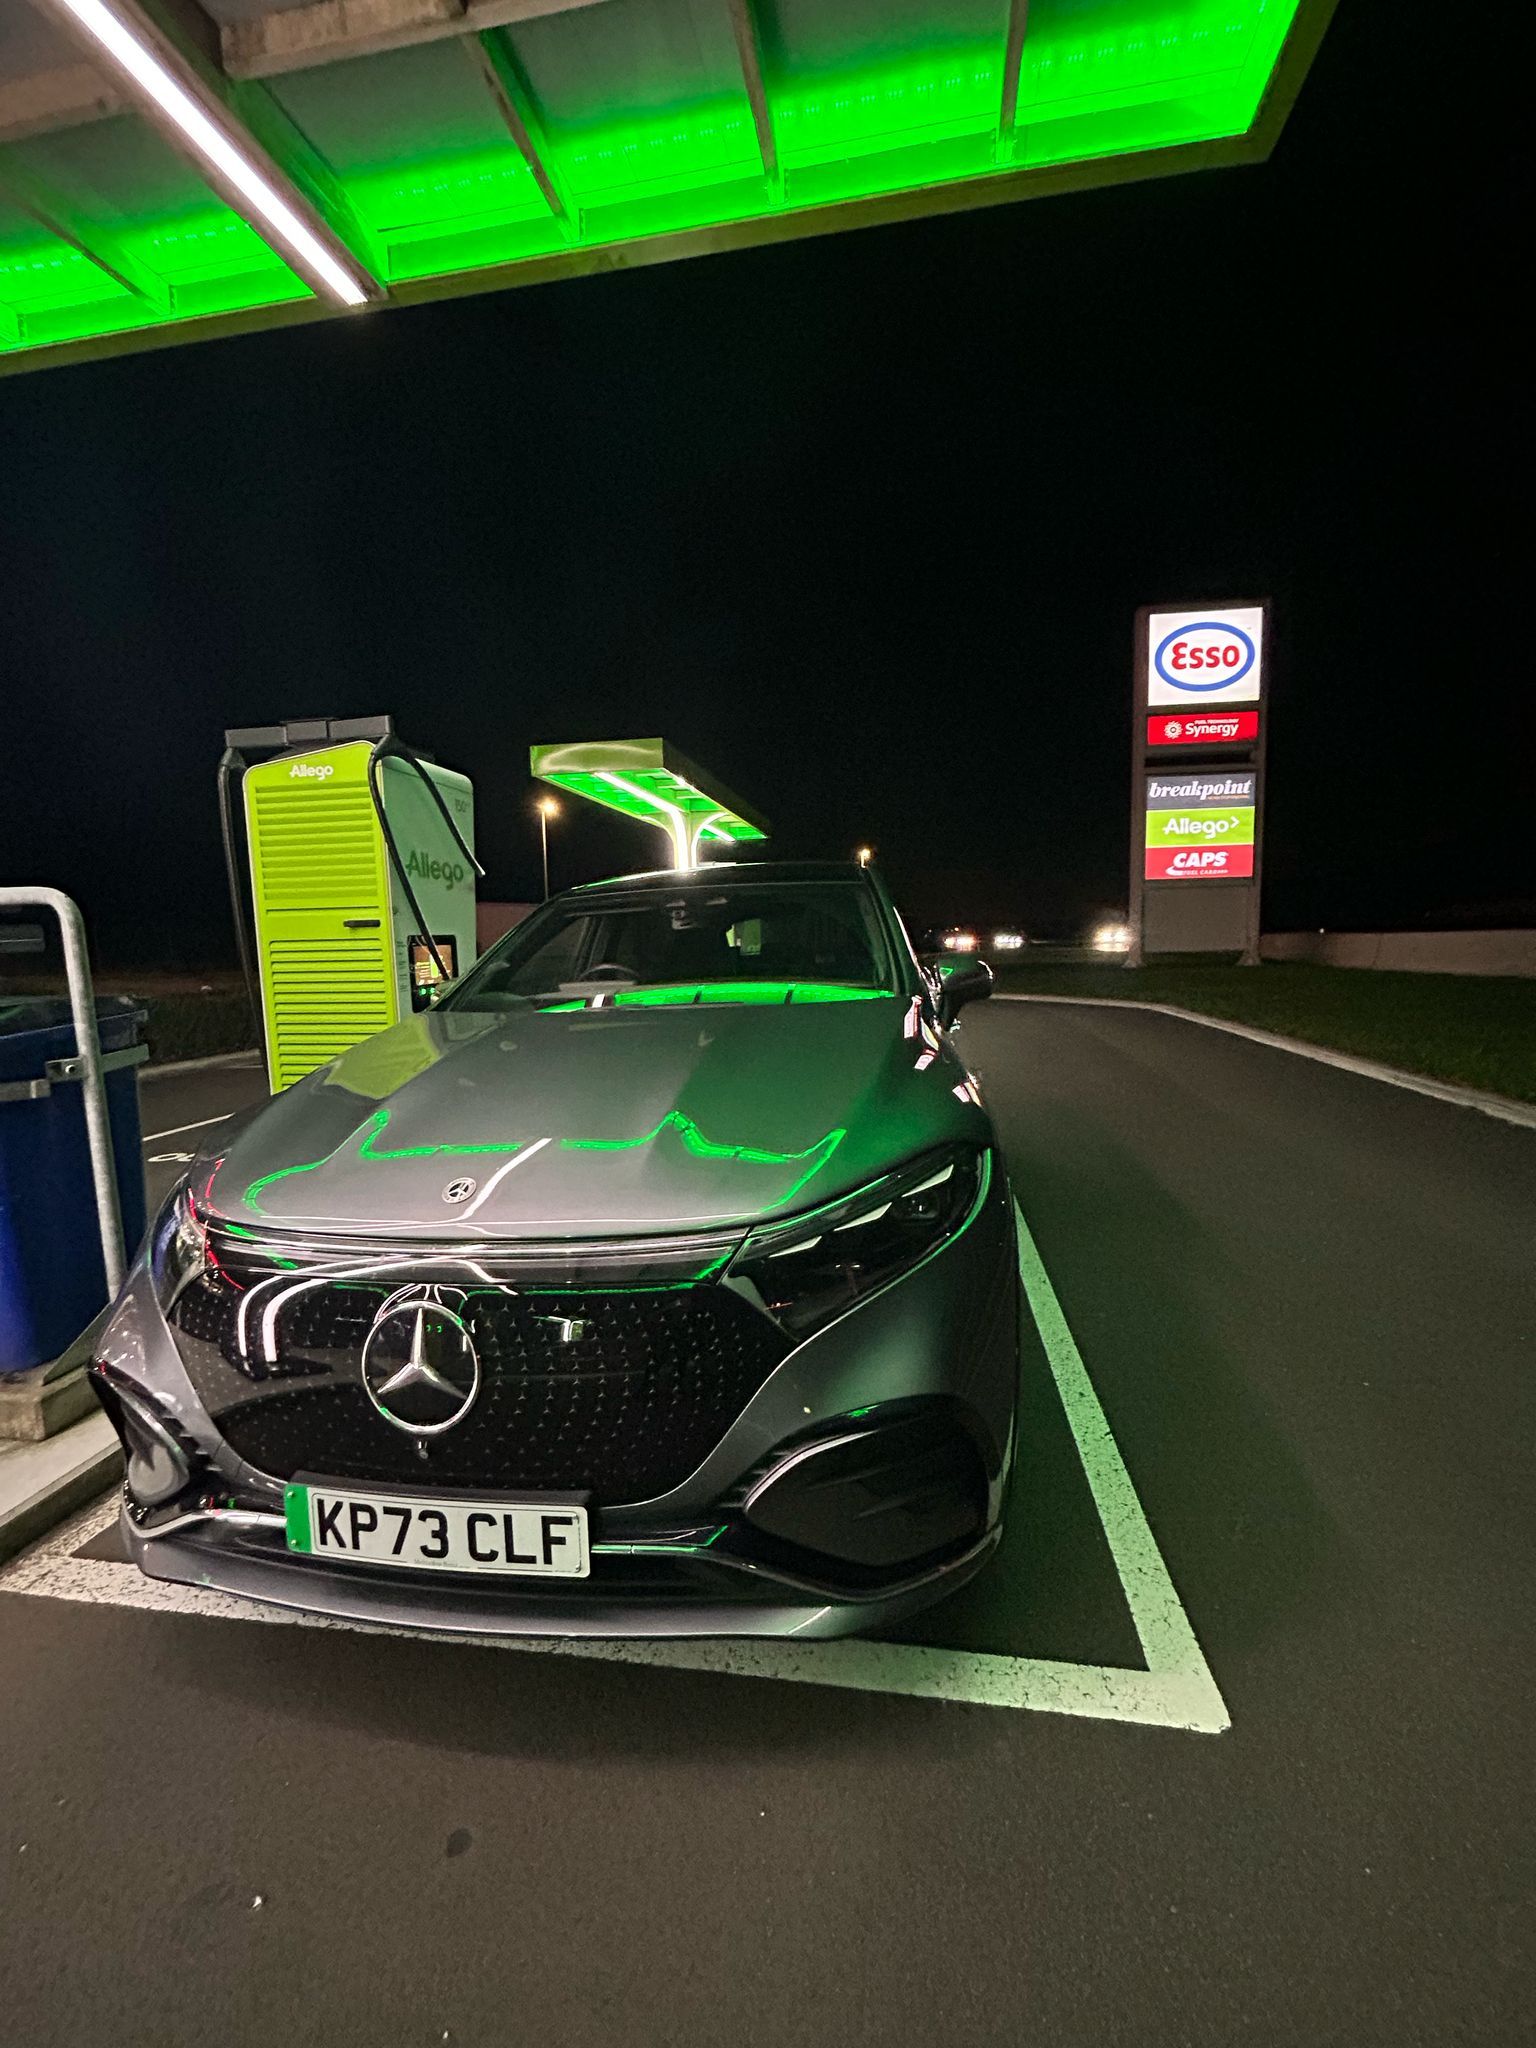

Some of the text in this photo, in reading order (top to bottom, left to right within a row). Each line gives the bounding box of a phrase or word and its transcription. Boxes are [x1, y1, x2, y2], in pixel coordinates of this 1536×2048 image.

[1171, 642, 1240, 670] Esso
[1185, 723, 1239, 737] Synergy
[289, 764, 334, 780] Allego
[1149, 780, 1252, 800] breakpoint
[1162, 817, 1229, 839] Allego
[406, 850, 464, 890] Allego
[1173, 852, 1229, 868] CAPS
[317, 1499, 573, 1565] KP73 CLF
